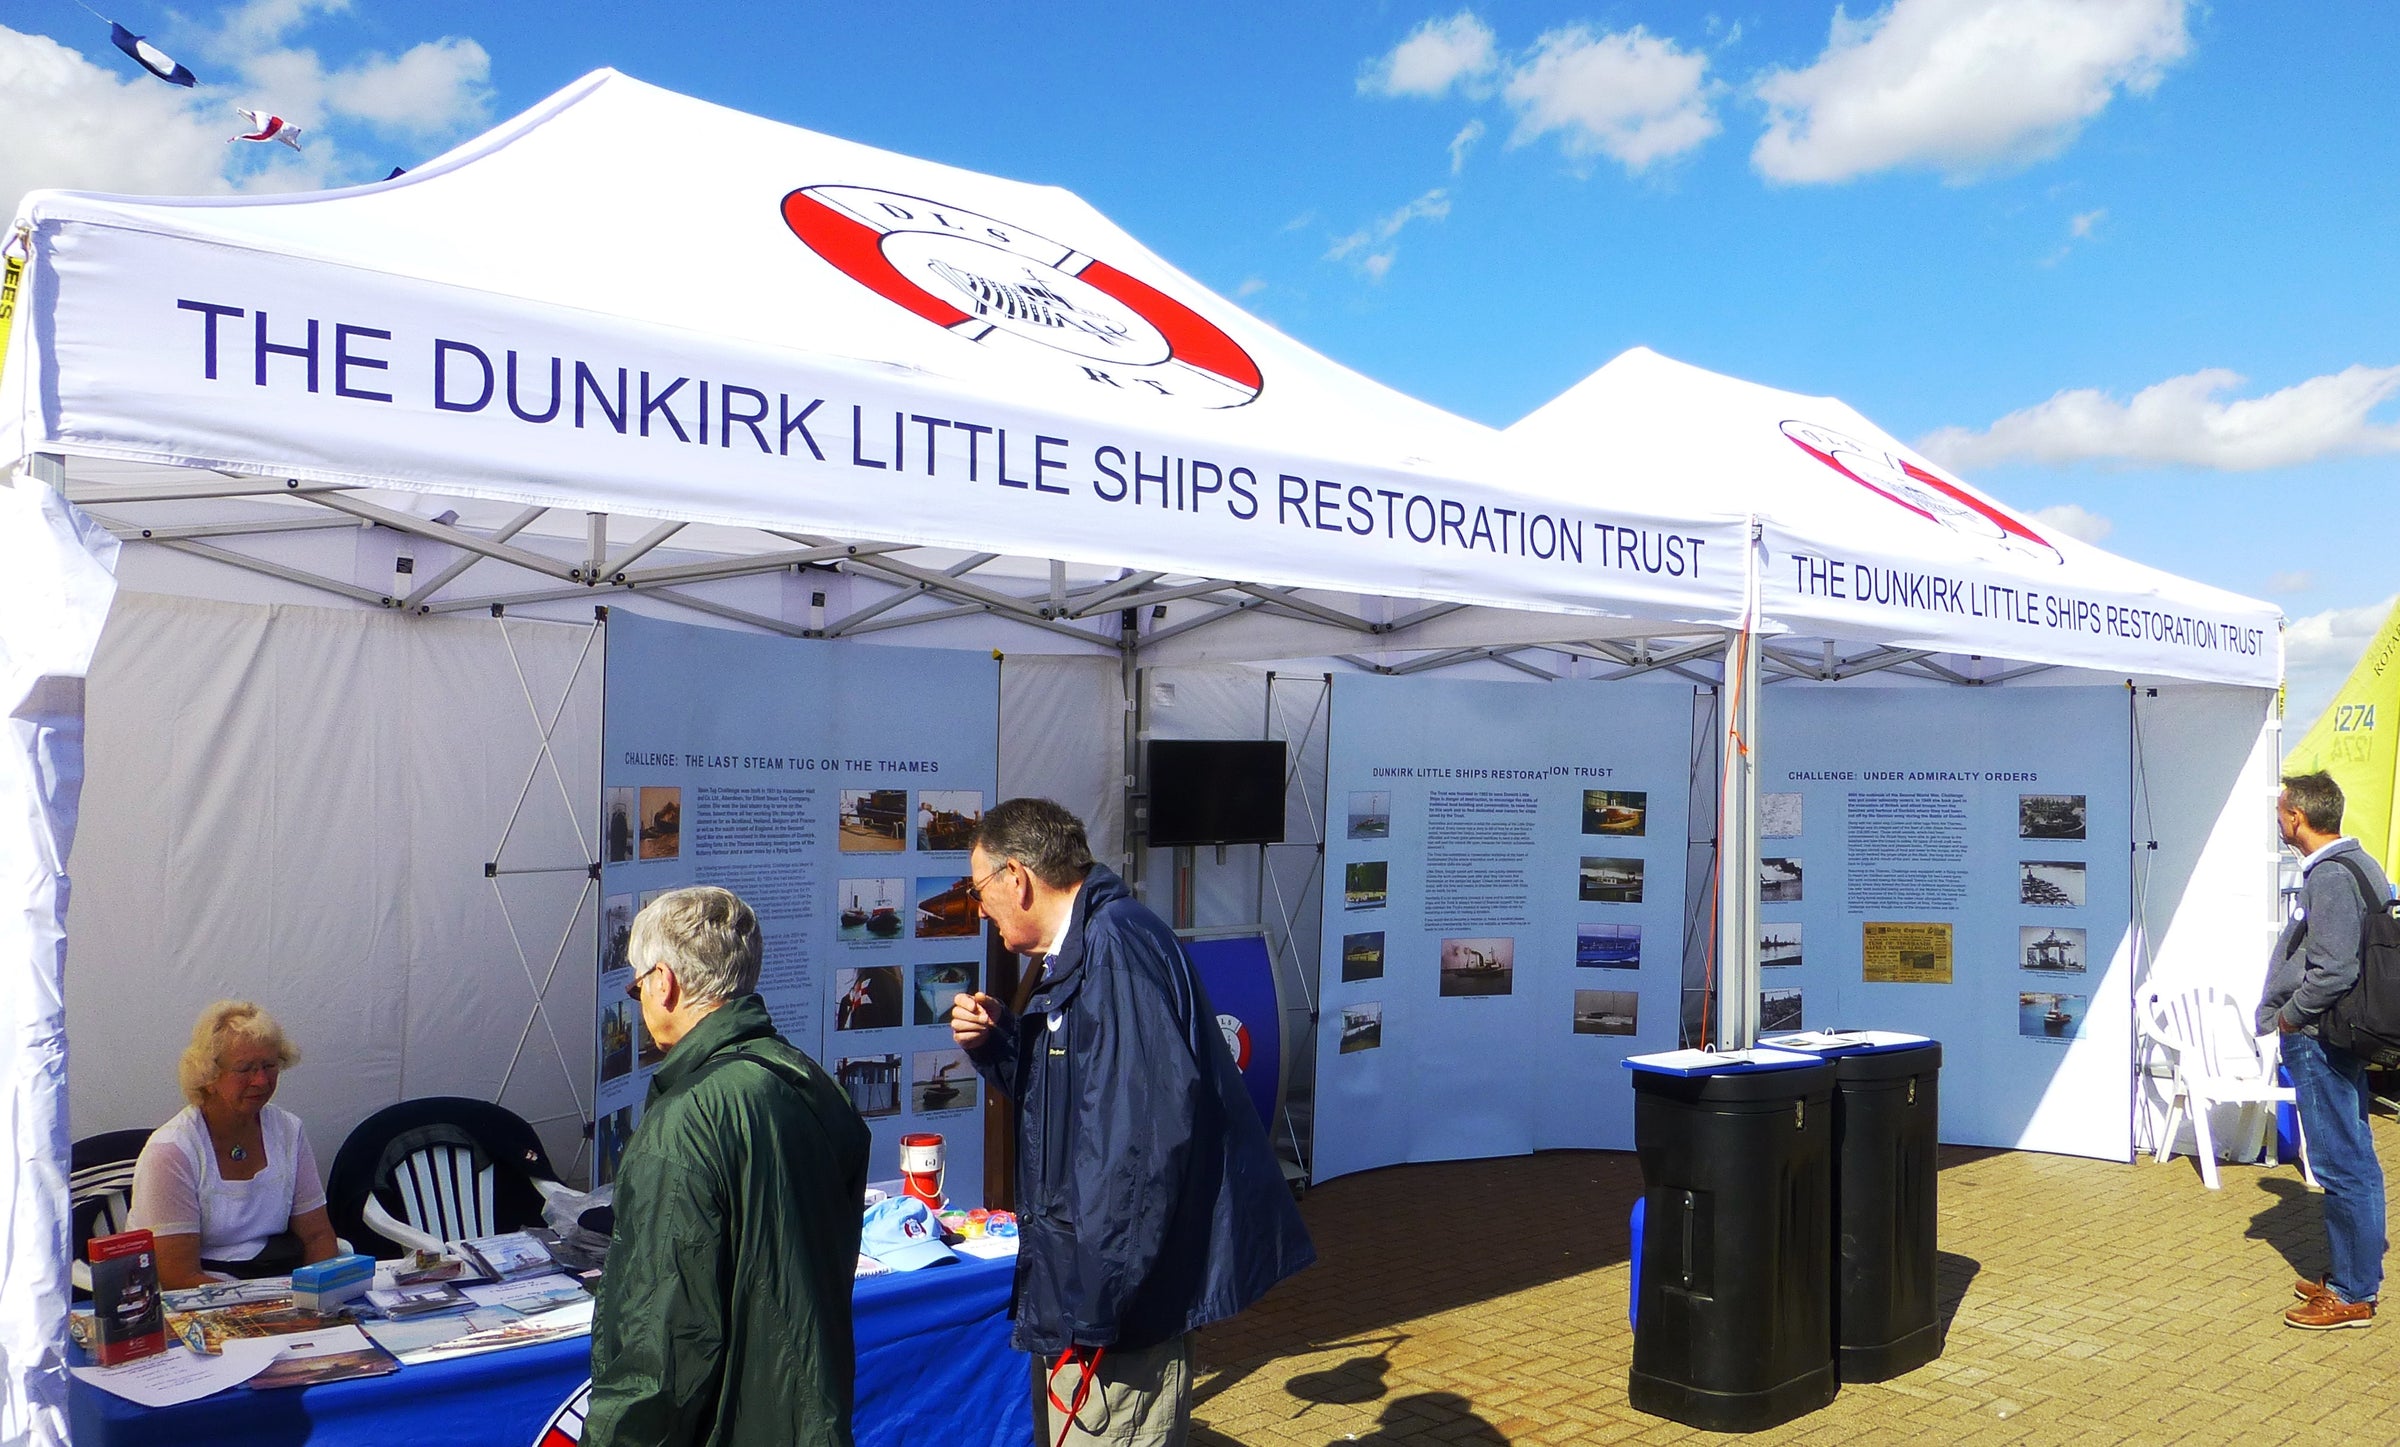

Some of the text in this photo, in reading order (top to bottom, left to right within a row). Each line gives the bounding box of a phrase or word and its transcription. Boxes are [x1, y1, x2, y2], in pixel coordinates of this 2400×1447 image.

[176, 297, 1706, 580] THE DUNKIRK LITTLE SHIPS RESTORATION TRUST
[1790, 554, 2264, 657] THE DUNKIRK LITTLE SHIPS RESTORATION TRUST
[625, 752, 939, 773] CHALLENGE: THE LAST STEAM TUG ON THE THAMES
[1372, 766, 1614, 780] DUNKIRK LITTLE SHIPS RESTORATION TRUST
[1788, 771, 2038, 781] CHALLENGE: UNDER ADMIRALTY ORDERS
